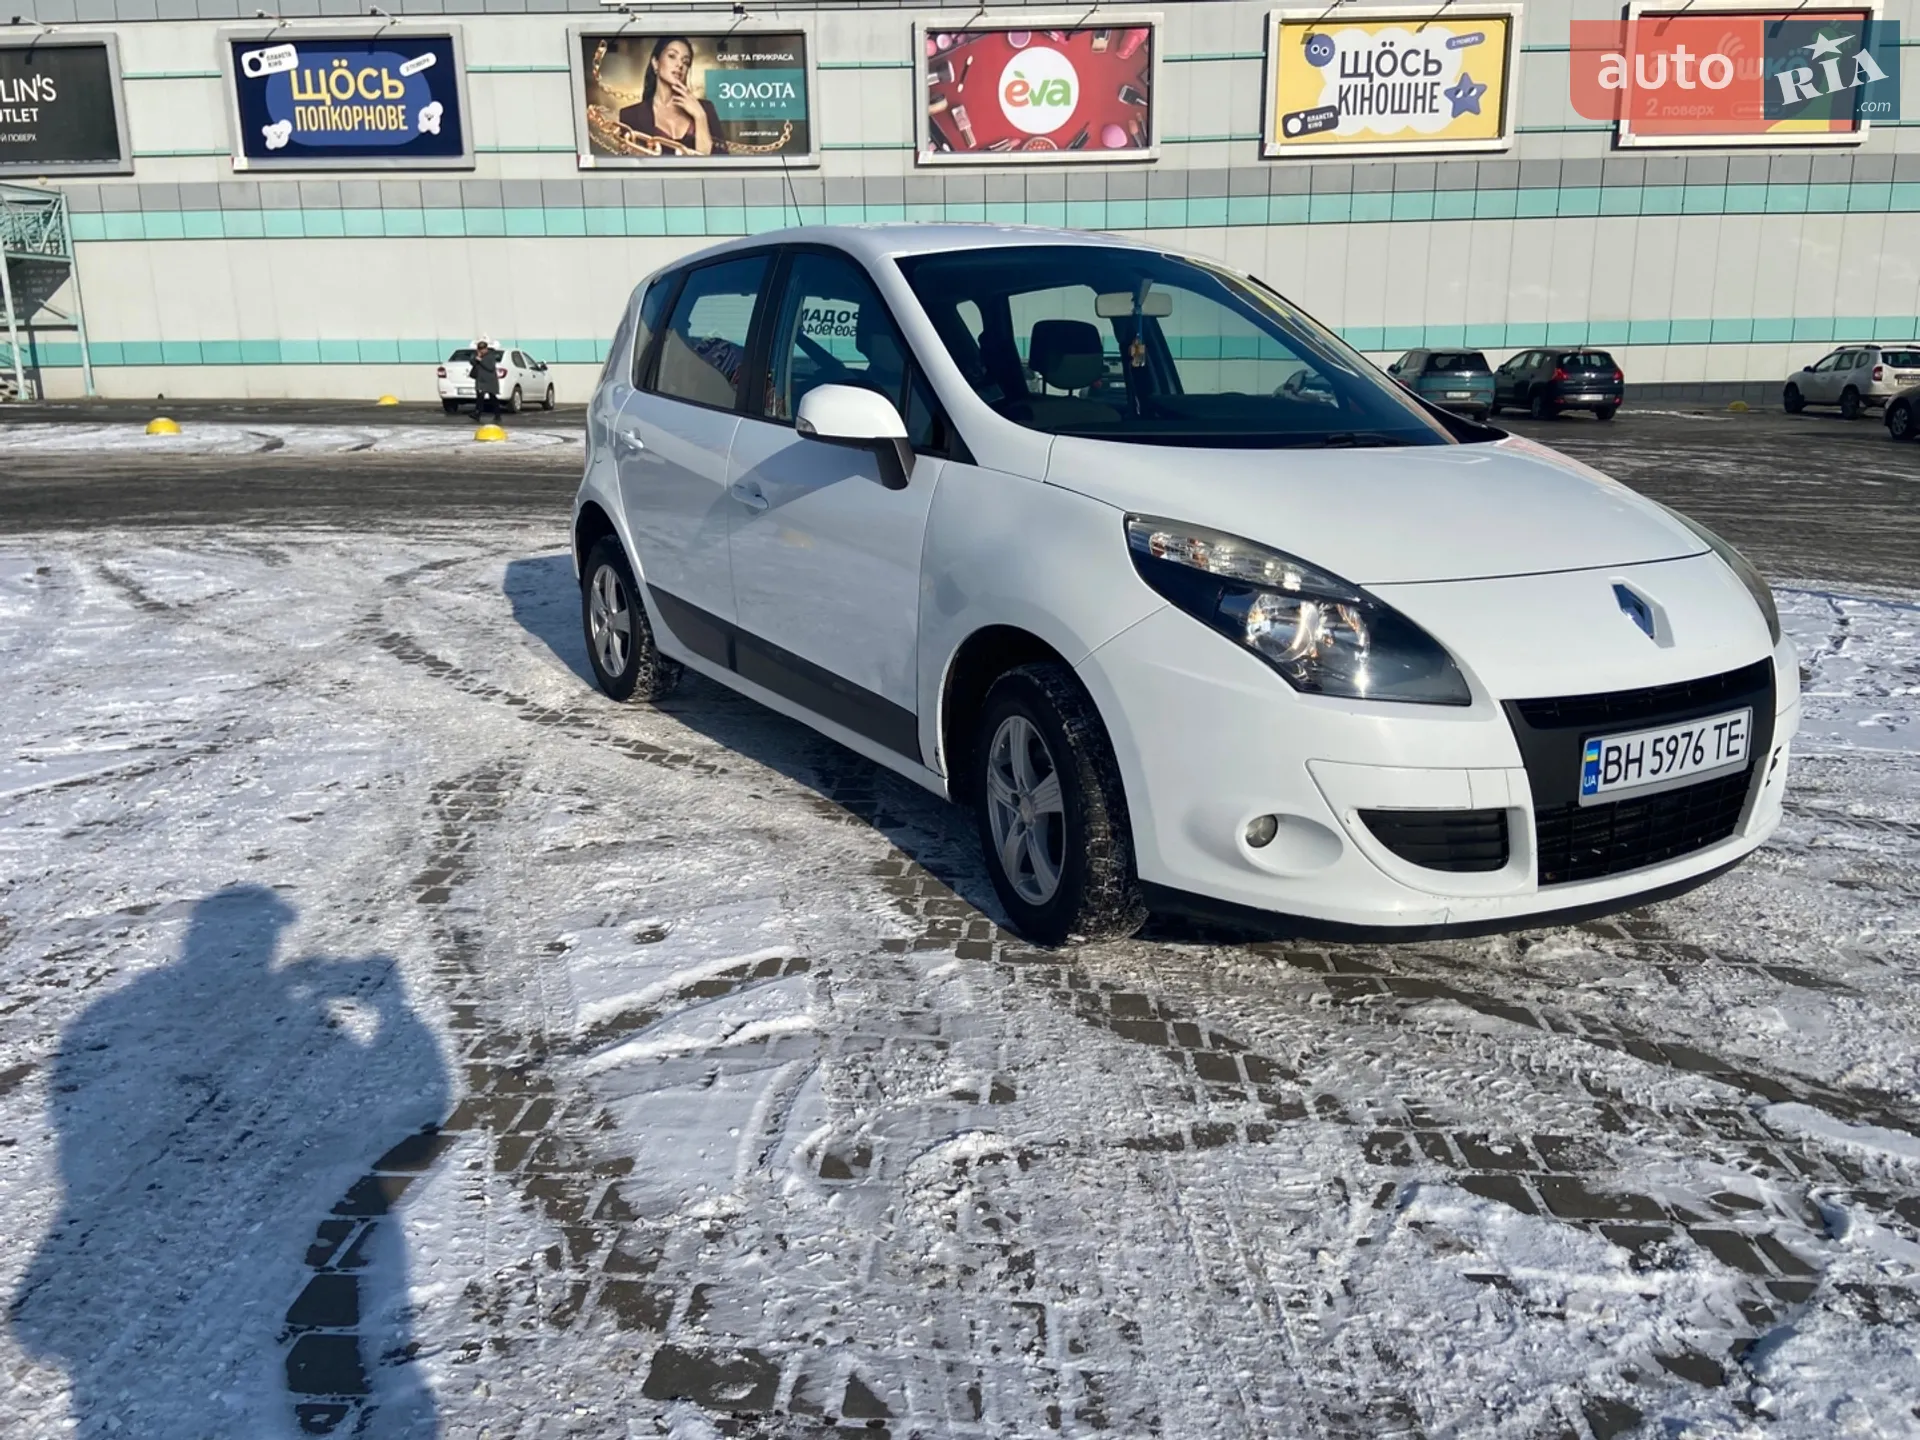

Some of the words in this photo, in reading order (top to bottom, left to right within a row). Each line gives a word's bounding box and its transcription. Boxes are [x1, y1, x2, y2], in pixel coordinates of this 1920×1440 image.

[717, 54, 739, 62] САМЕ
[752, 53, 794, 61] ПРИКРАСА
[718, 82, 796, 99] ЗОЛОТА
[1338, 81, 1441, 116] КІНОШНЕ
[1307, 111, 1334, 122] ПЛАНЕТА
[1645, 98, 1658, 116] 2
[1662, 104, 1714, 119] поверх
[294, 105, 408, 132] ПОПКОРНОВЕ
[1602, 740, 1645, 785] BH
[1650, 728, 1706, 775] 5976
[1713, 718, 1741, 760] TE
[1584, 775, 1596, 787] UA
